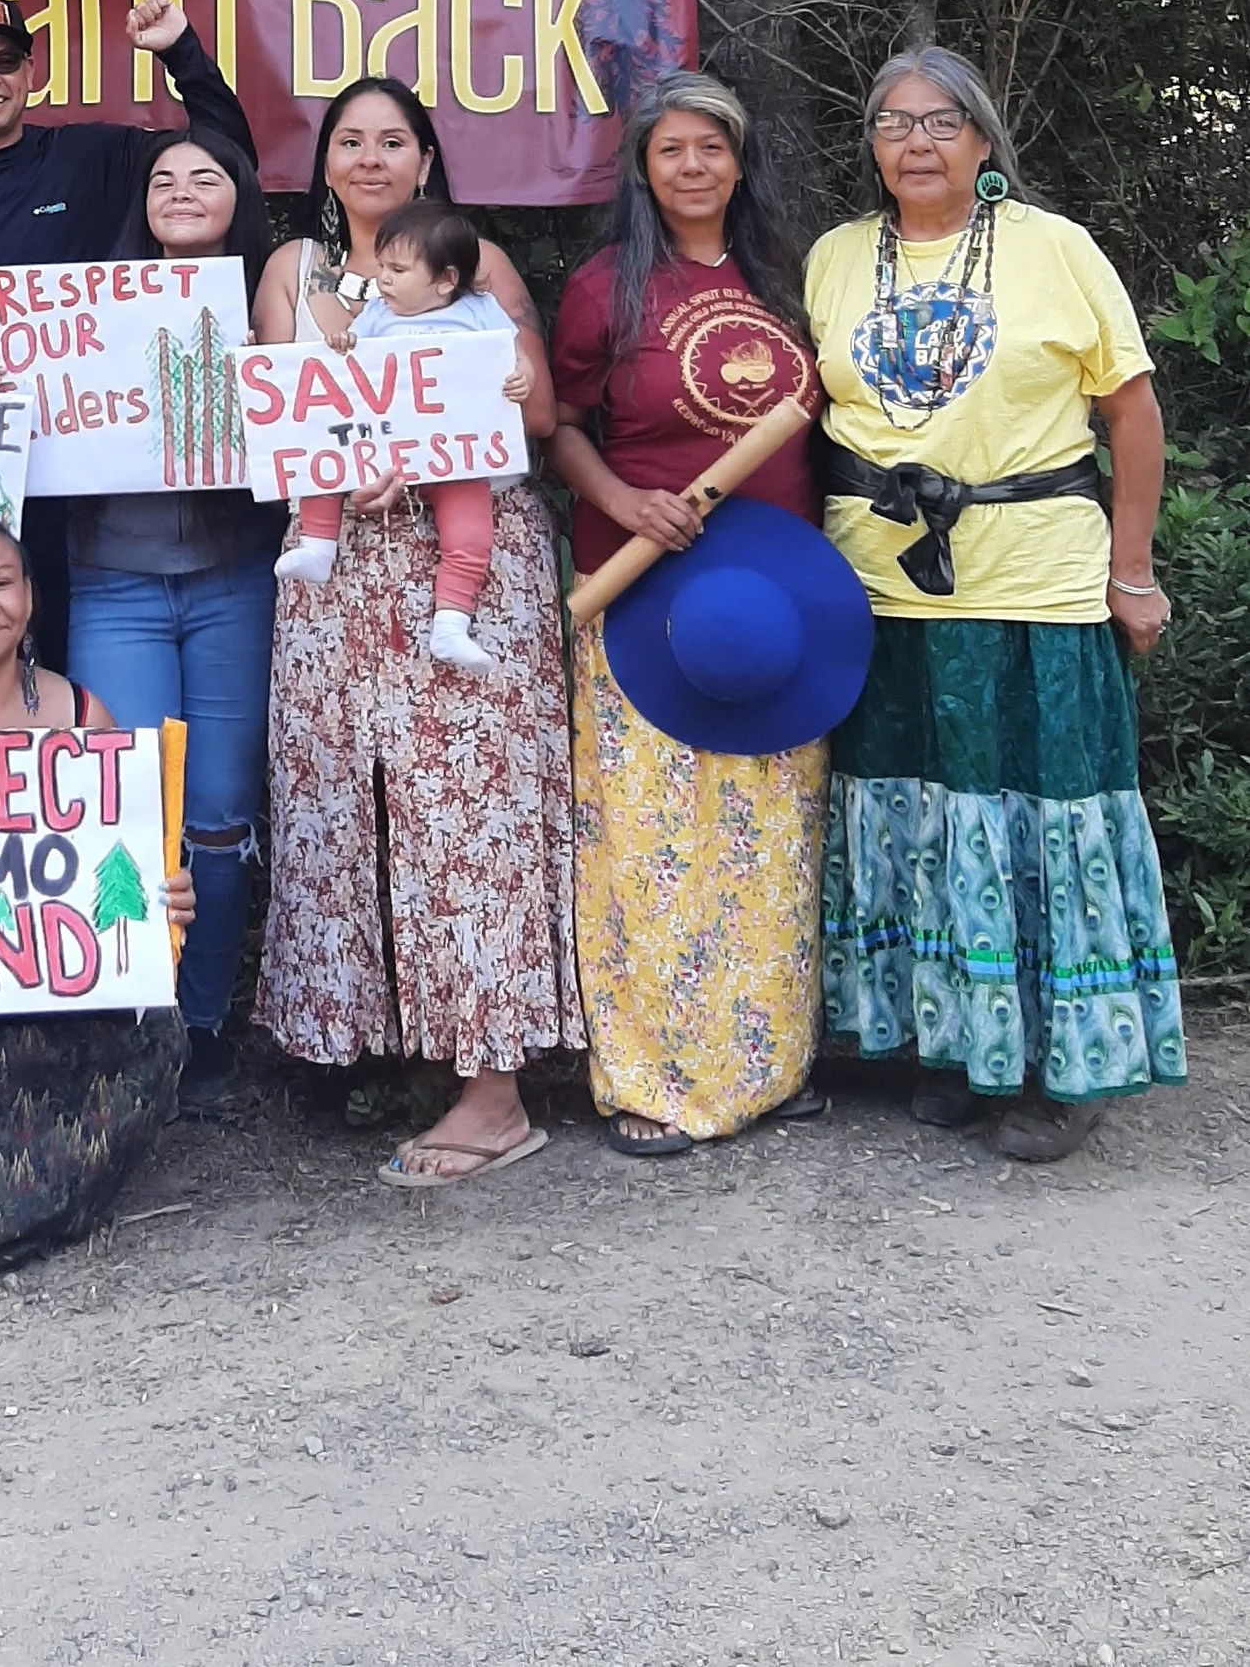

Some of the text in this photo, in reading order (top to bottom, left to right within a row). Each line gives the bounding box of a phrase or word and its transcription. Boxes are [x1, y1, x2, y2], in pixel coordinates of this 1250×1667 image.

[0, 312, 105, 374] OUR
[914, 342, 967, 367] BAK
[246, 348, 445, 424] SAVE
[328, 420, 393, 447] THE
[274, 431, 510, 500] FORESTS
